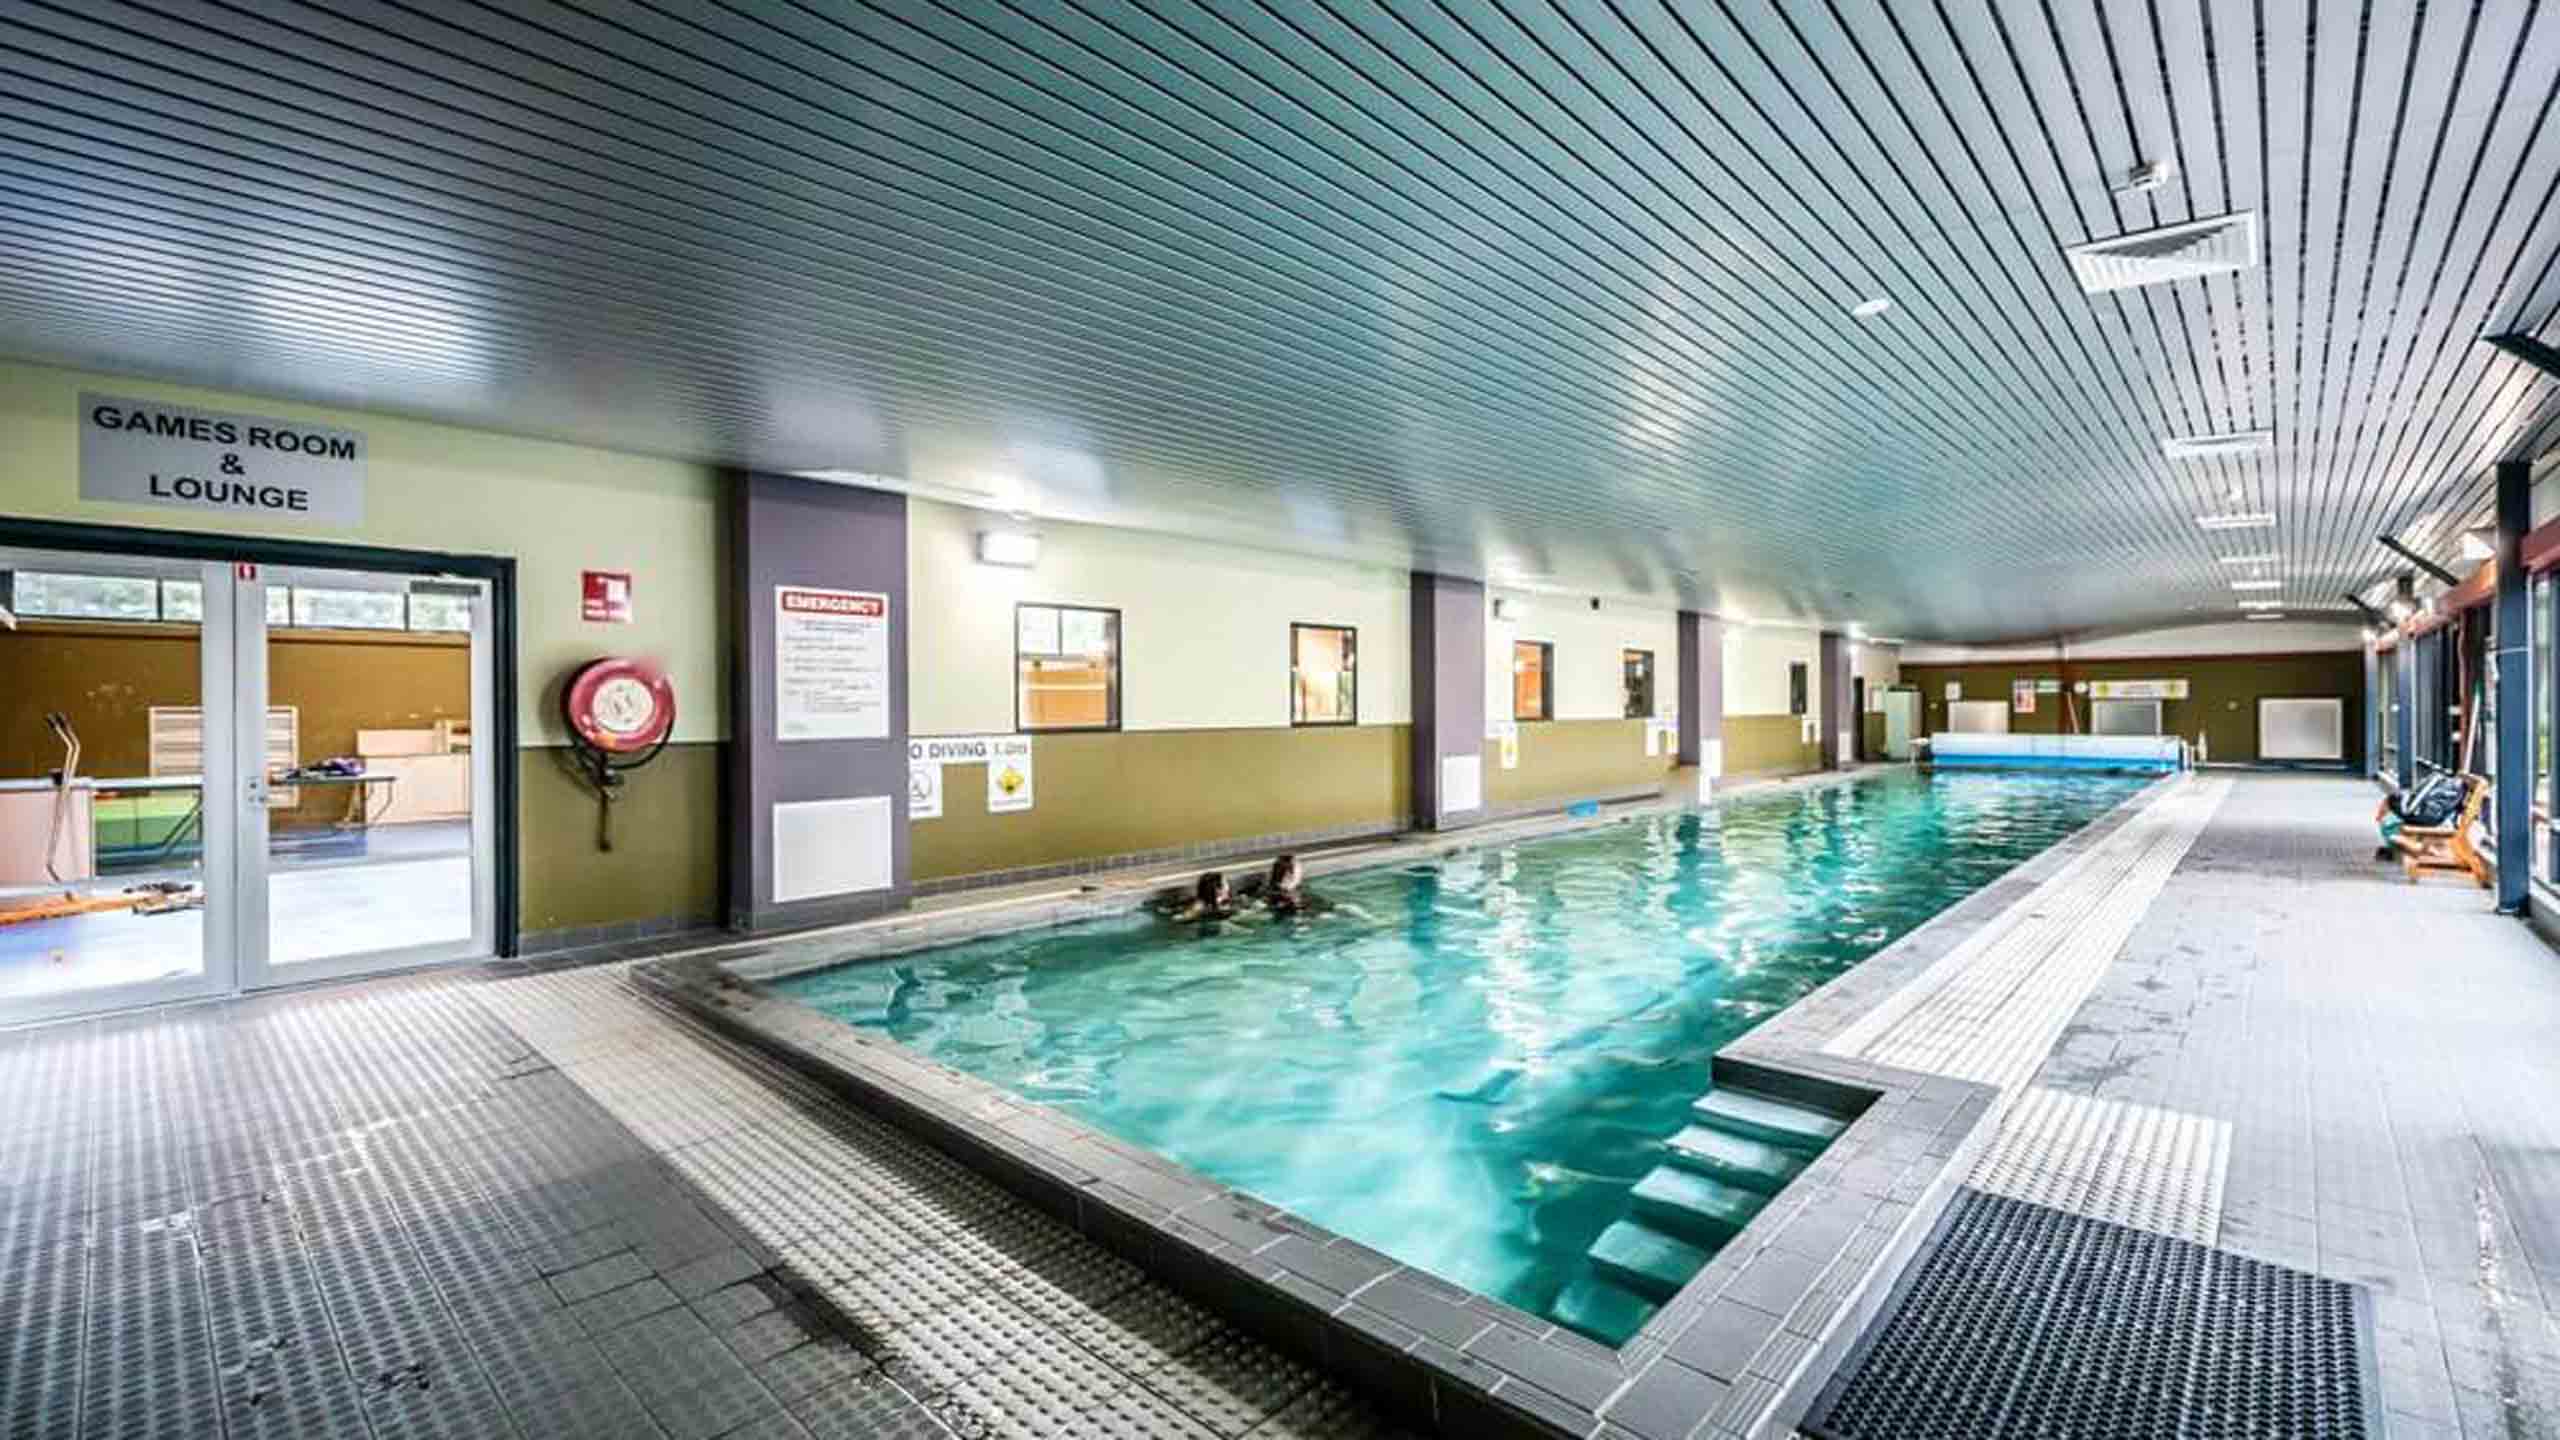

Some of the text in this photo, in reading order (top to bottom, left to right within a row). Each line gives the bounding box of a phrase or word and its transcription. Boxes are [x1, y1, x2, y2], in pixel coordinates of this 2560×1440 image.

[92, 405, 356, 461] GAMES ROOM
[219, 452, 245, 475] &
[149, 474, 310, 512] LOUNGE
[784, 594, 881, 614] EMERGENCY
